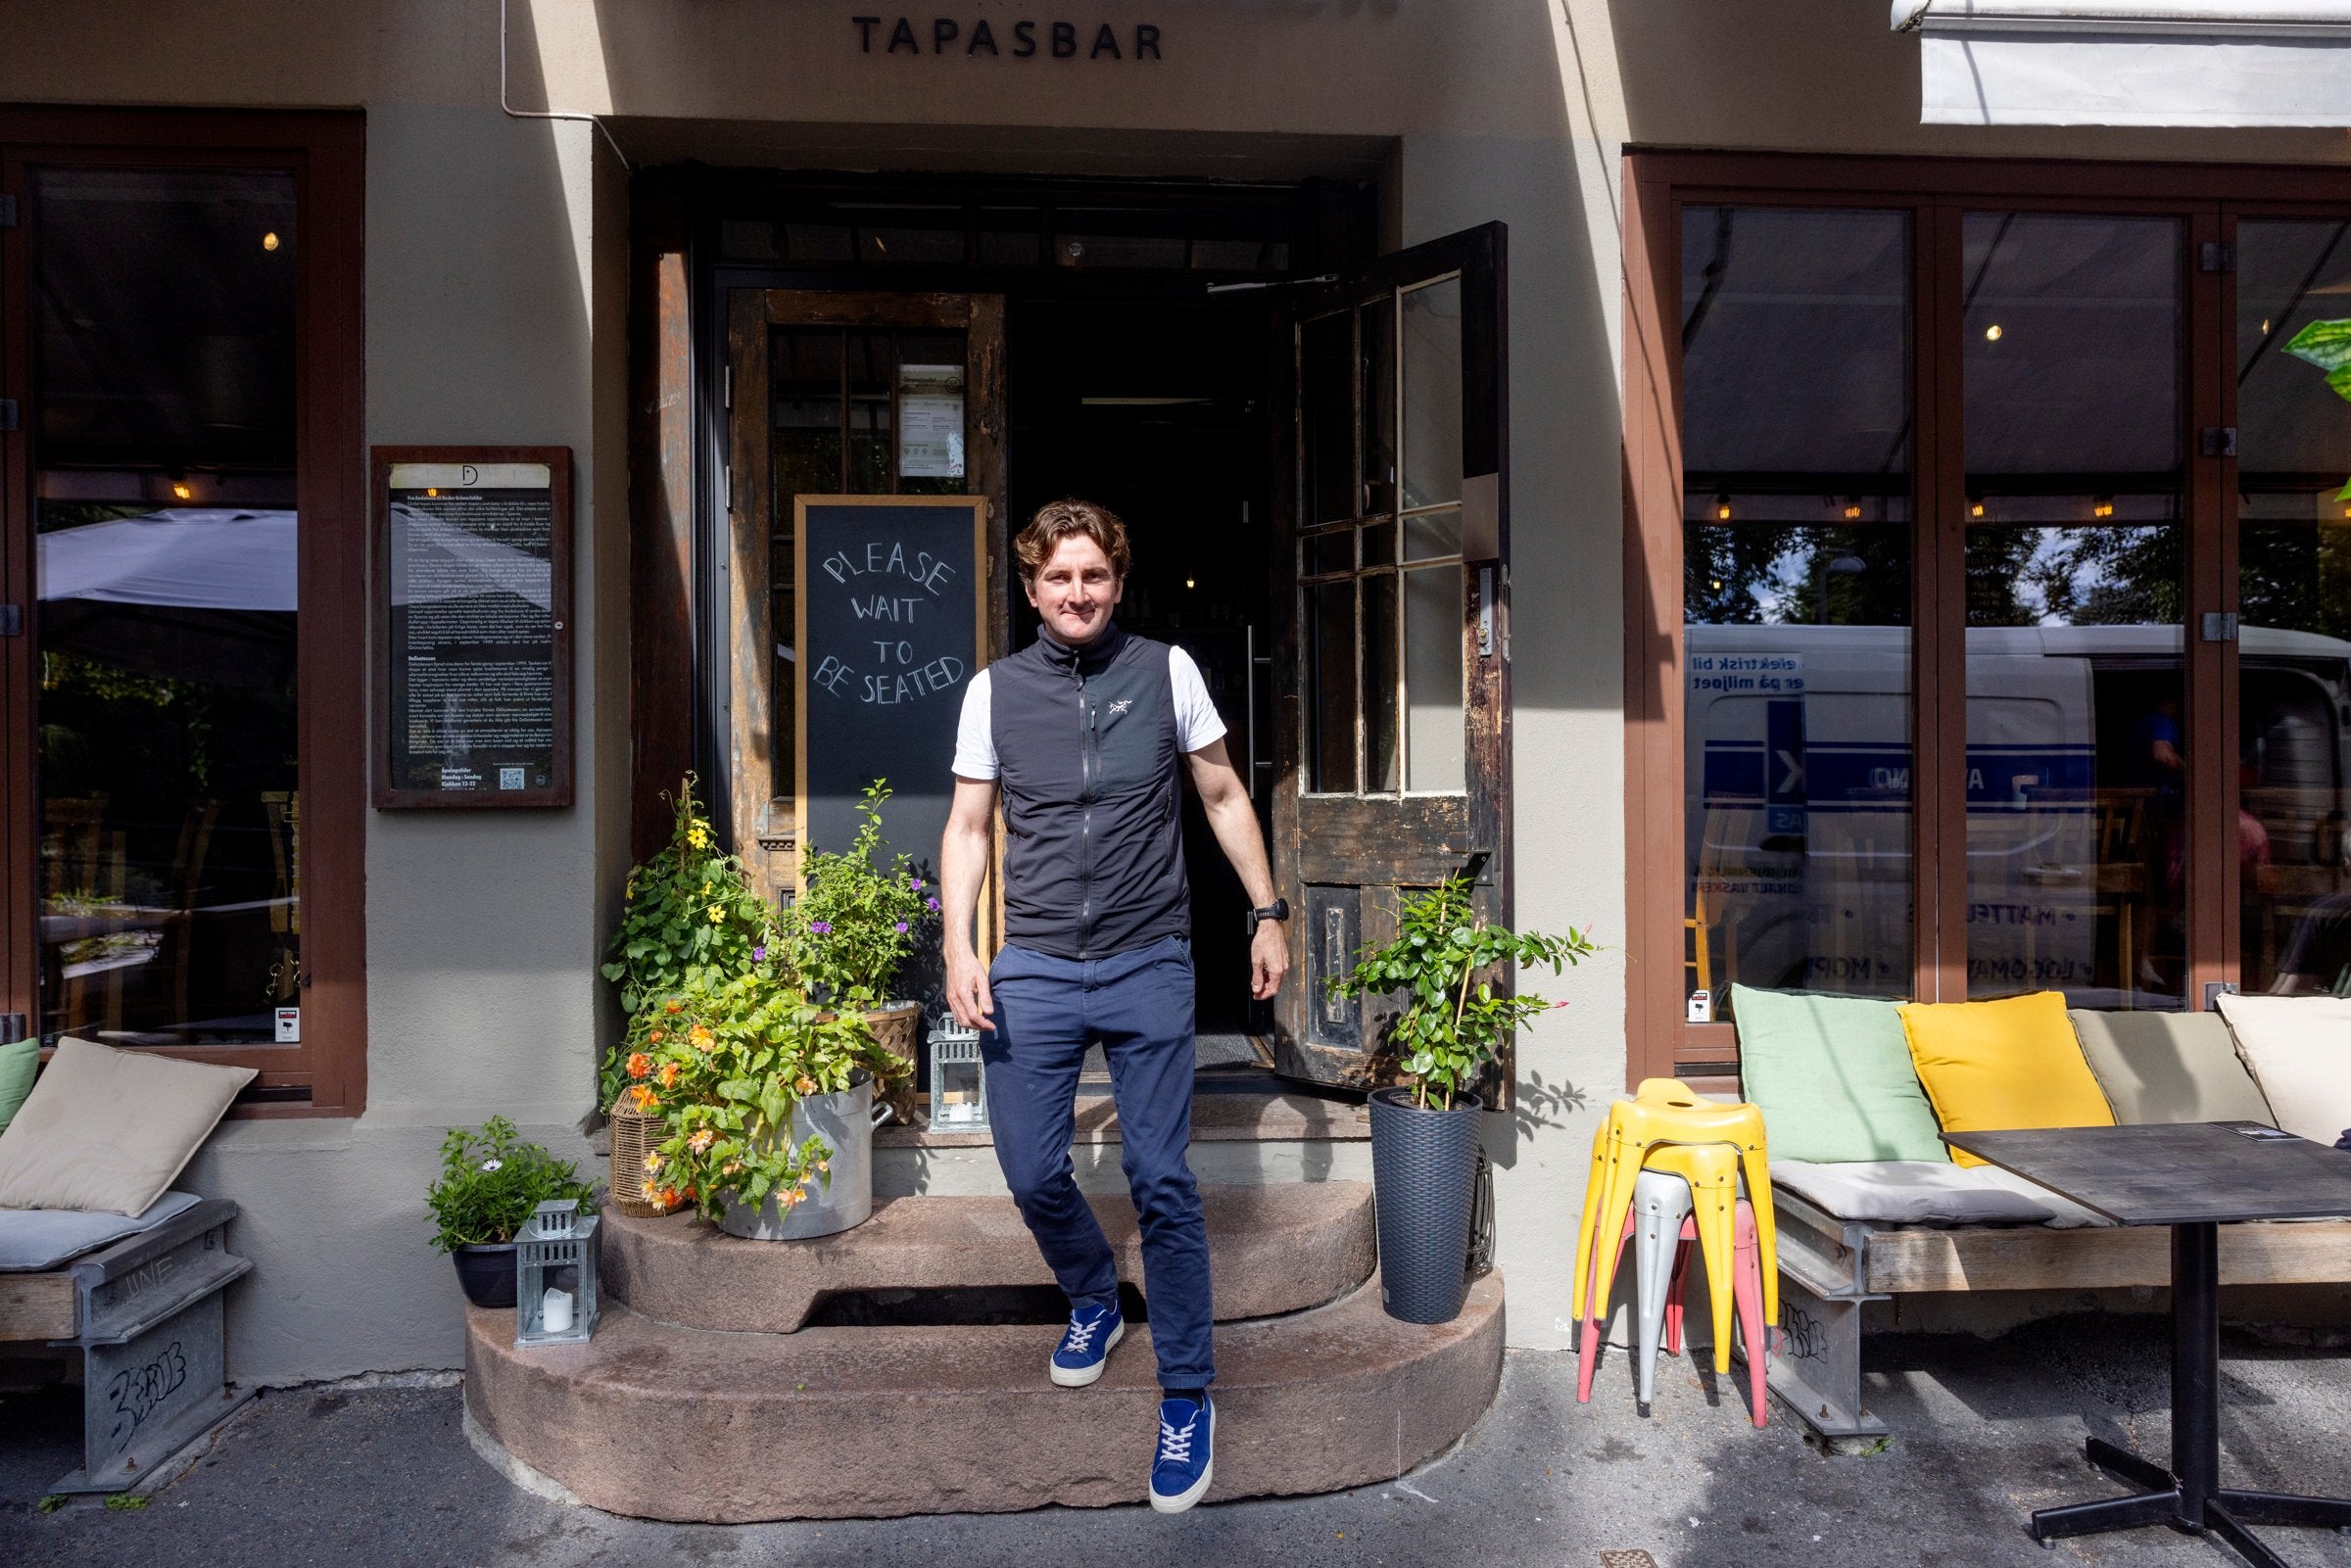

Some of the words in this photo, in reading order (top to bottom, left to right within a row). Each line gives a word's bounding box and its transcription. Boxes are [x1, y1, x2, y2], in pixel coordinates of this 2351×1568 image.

[851, 16, 1163, 61] TAPASBAR
[822, 540, 957, 597] PLEASE
[850, 595, 925, 624] WAIT
[872, 639, 914, 665] TO
[812, 654, 856, 698] BE
[859, 654, 965, 705] SEATED
